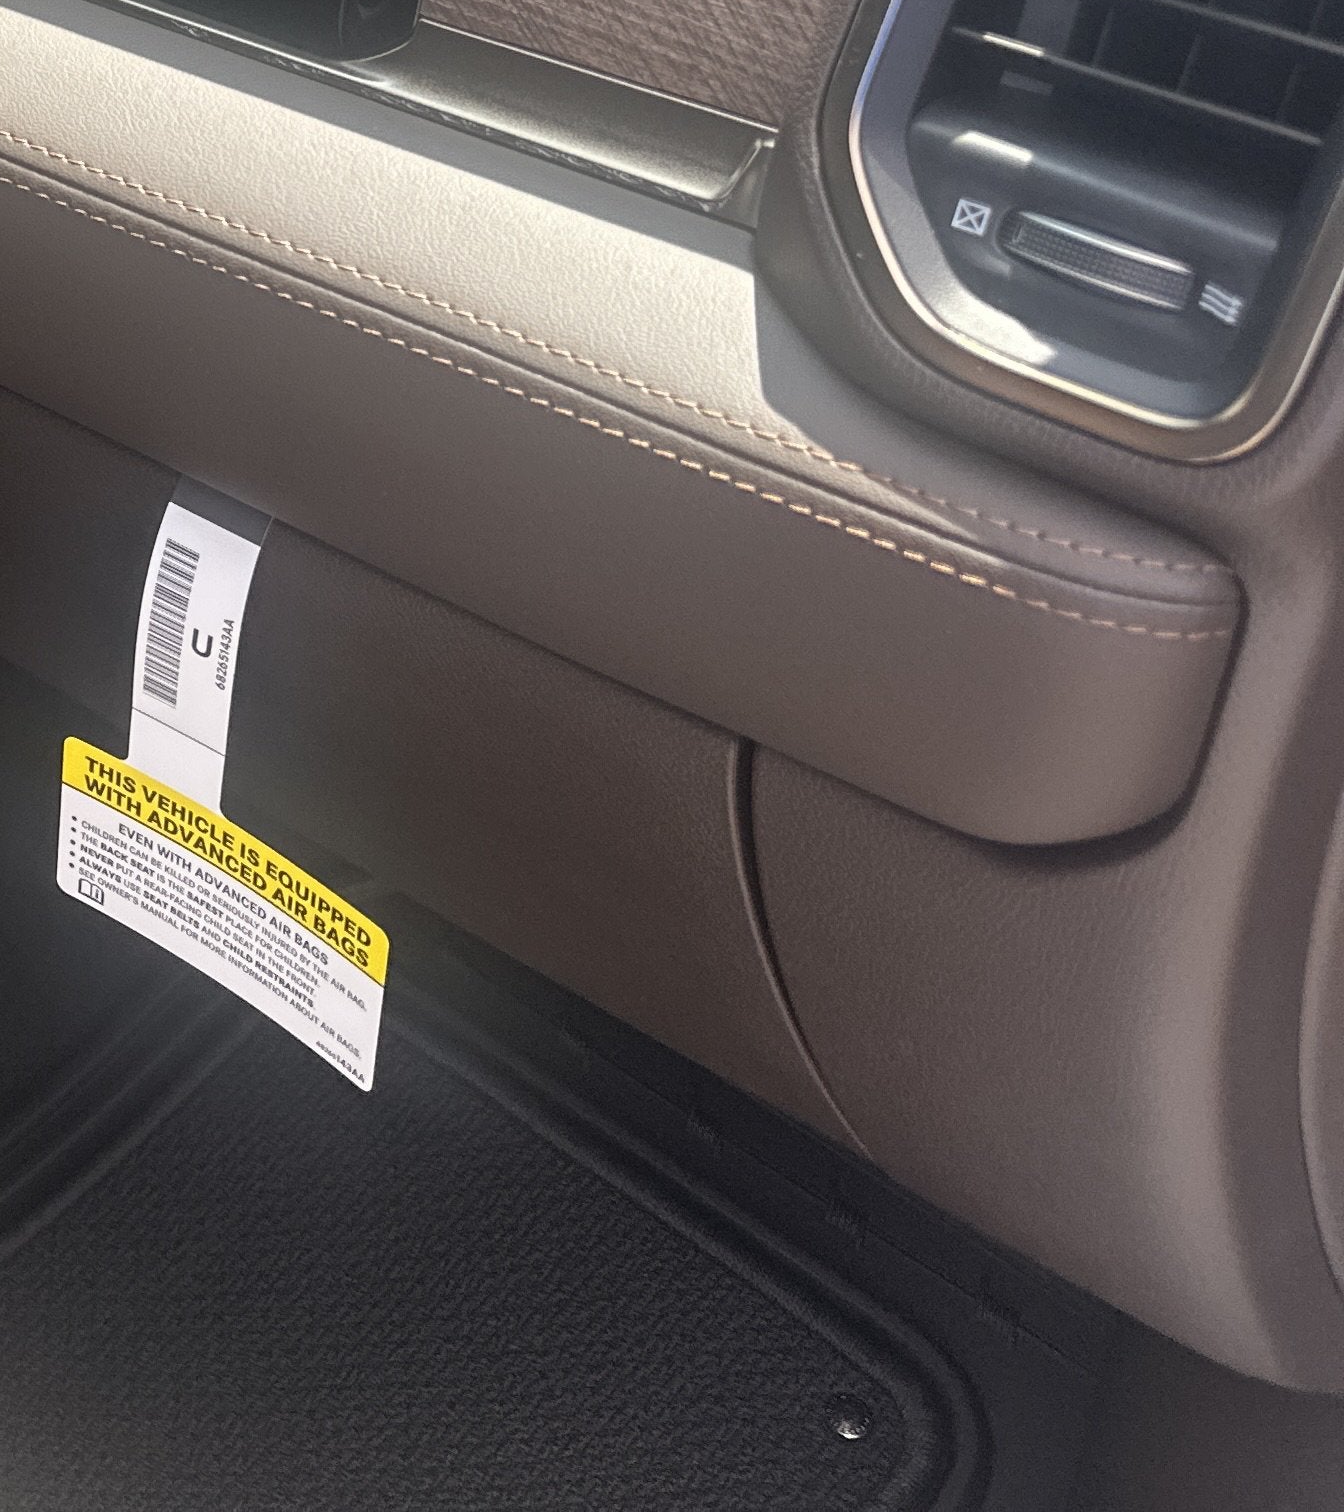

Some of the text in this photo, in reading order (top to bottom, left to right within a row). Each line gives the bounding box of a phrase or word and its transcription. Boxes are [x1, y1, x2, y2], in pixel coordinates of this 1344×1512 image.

[192, 628, 213, 658] U
[215, 618, 235, 691] 68265143AA
[80, 842, 316, 998] NEVER PUT A REAR-FACING CHILD SEAT IN THE FRONT.
[84, 755, 371, 949] THIS VEHICLE IS EQUIPPED
[84, 773, 369, 968] WITH ADVANCED AIR BAGS
[118, 822, 328, 966] EVEN WITH ADVANCED AIR BAGS
[79, 854, 315, 1010] ALWAYS USE SEAT BELTS AND CHILD RESTRAINTS.
